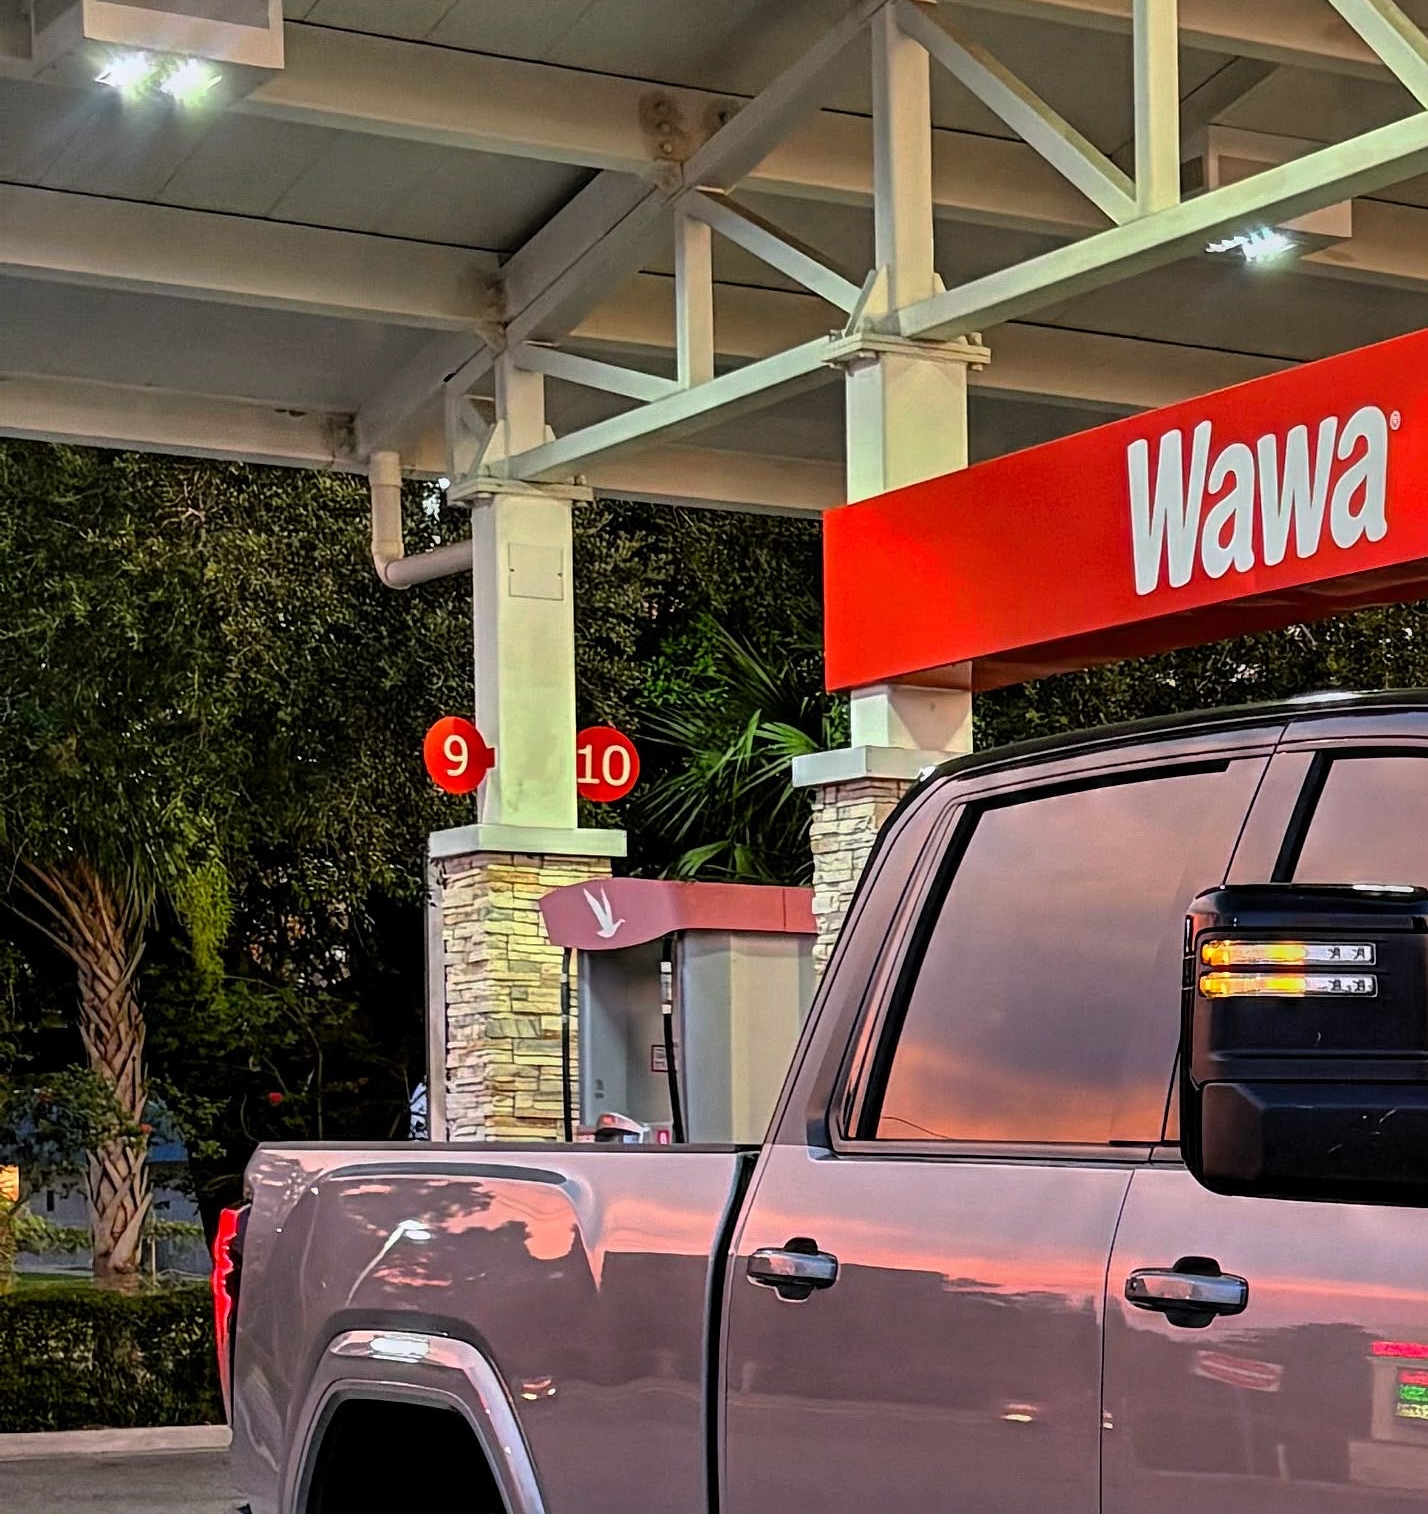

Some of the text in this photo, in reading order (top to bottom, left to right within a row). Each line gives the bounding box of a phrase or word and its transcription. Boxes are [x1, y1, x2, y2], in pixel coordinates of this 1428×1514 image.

[1127, 405, 1388, 596] Wawa
[443, 734, 468, 777] 9
[577, 743, 631, 787] 10
